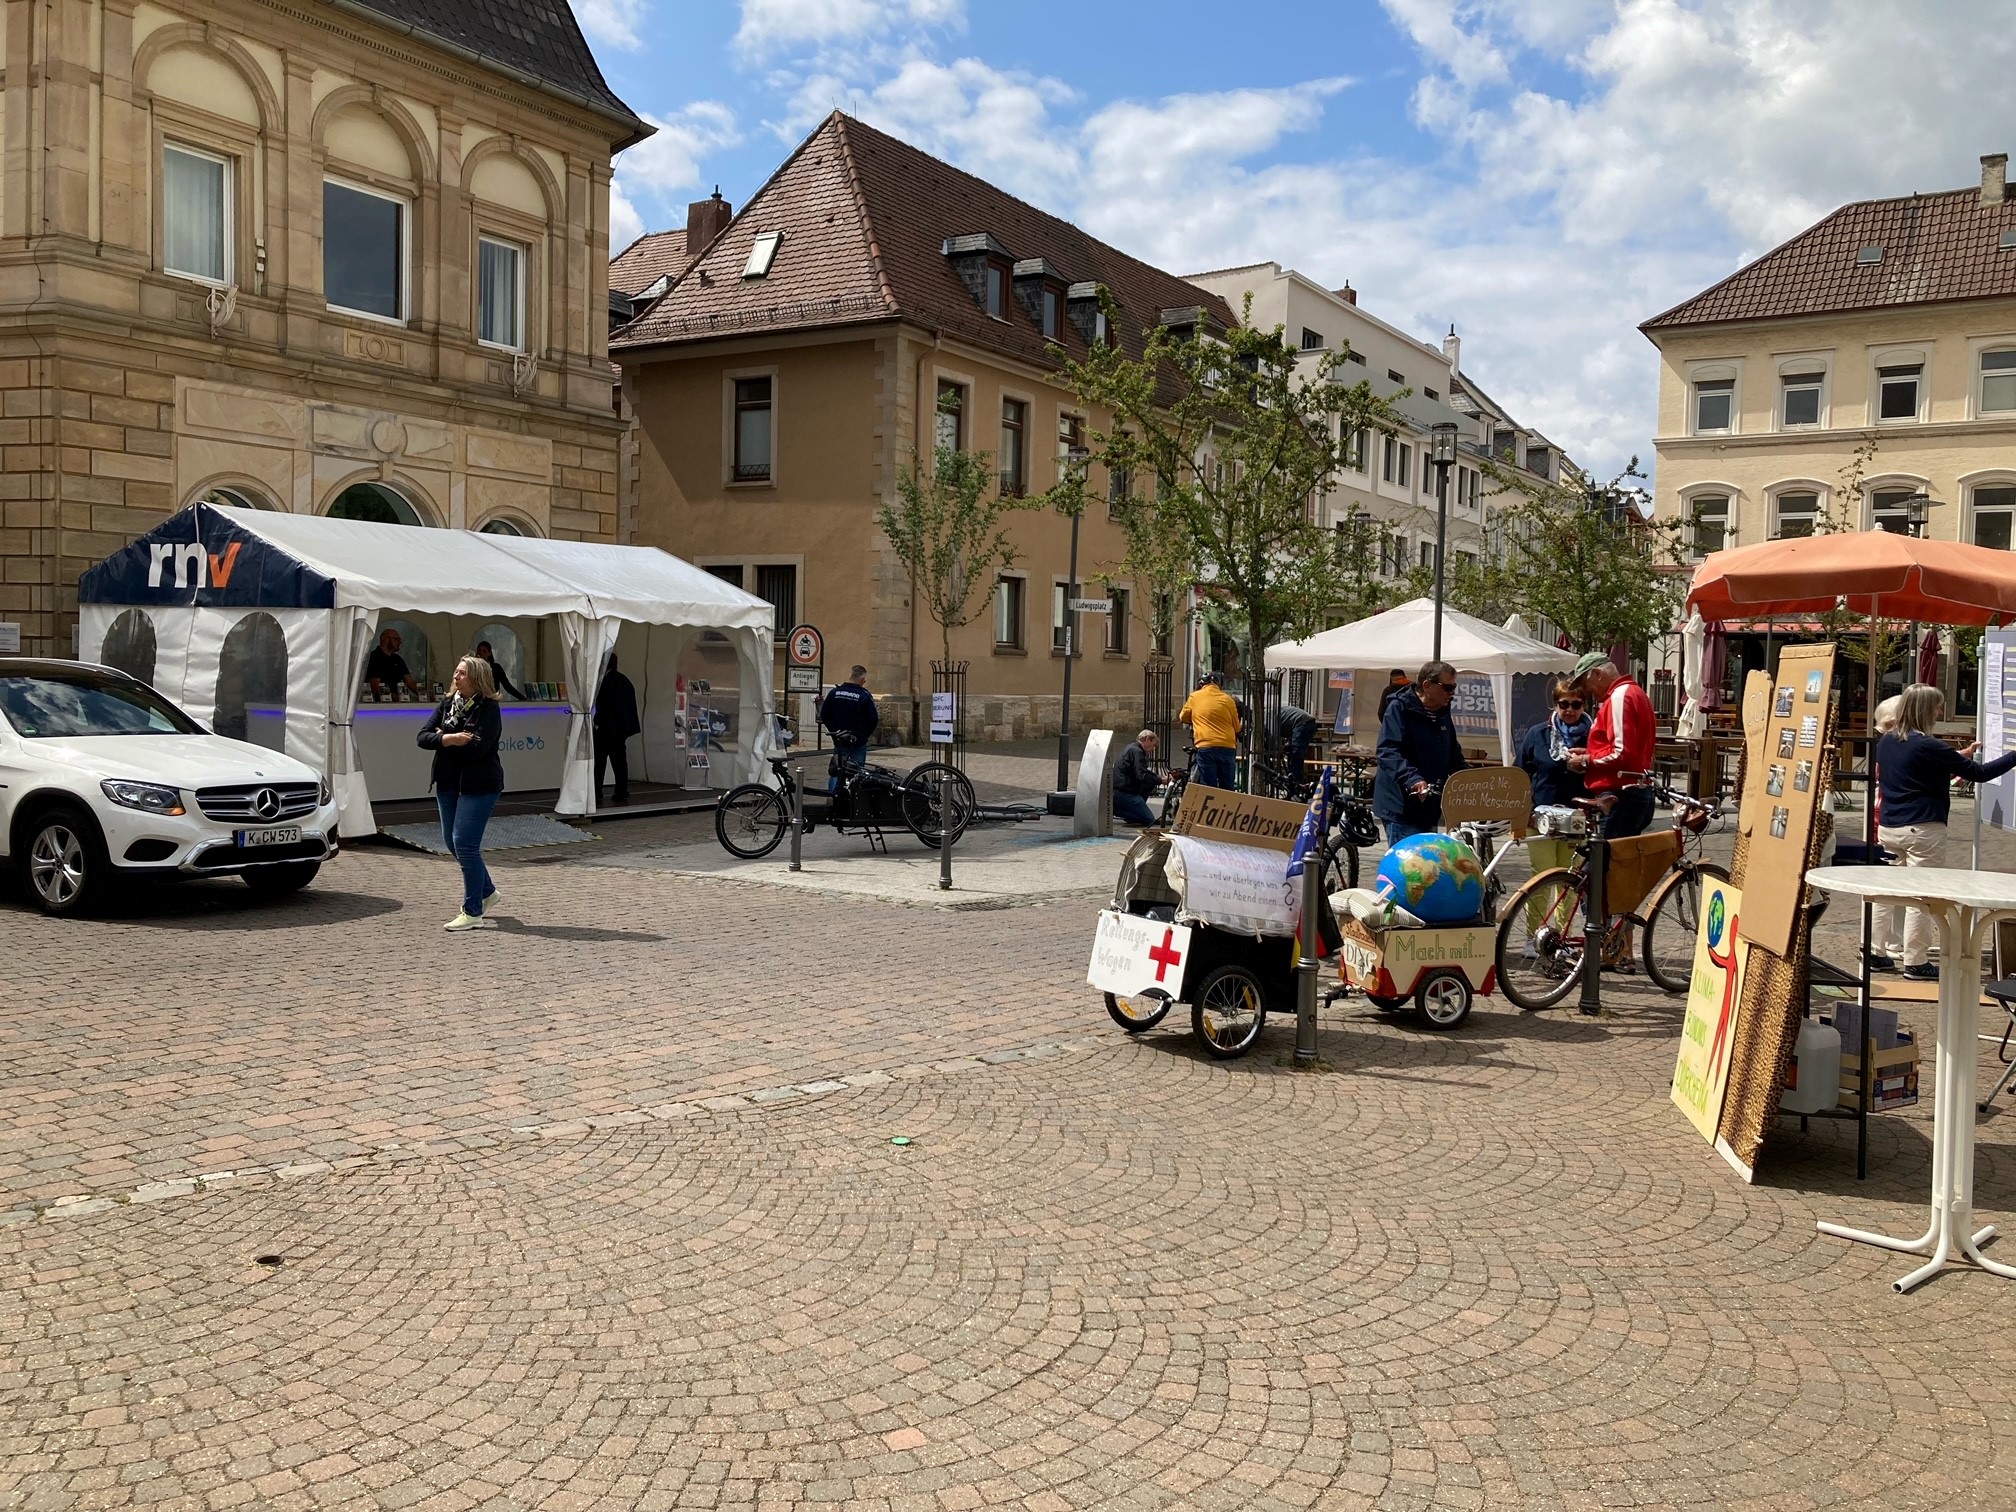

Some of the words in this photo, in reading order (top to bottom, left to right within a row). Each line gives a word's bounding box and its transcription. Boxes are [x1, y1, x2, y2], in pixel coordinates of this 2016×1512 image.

[148, 542, 241, 587] rnv
[1075, 600, 1107, 611] Ludwigsplatz
[793, 672, 815, 680] Anlieger
[1448, 793, 1461, 806] ich
[1463, 792, 1477, 806] hab
[248, 832, 256, 845] K
[262, 831, 277, 843] CW
[278, 829, 297, 842] 573
[1223, 872, 1231, 881] wir
[1233, 874, 1265, 889] überlegen
[1266, 881, 1278, 890] was
[1210, 889, 1221, 897] wir
[1222, 891, 1231, 899] zu
[1233, 889, 1257, 903] Abend
[1101, 916, 1150, 952] Rettungs-
[1395, 933, 1446, 962] Mach
[1097, 946, 1132, 976] Wagen
